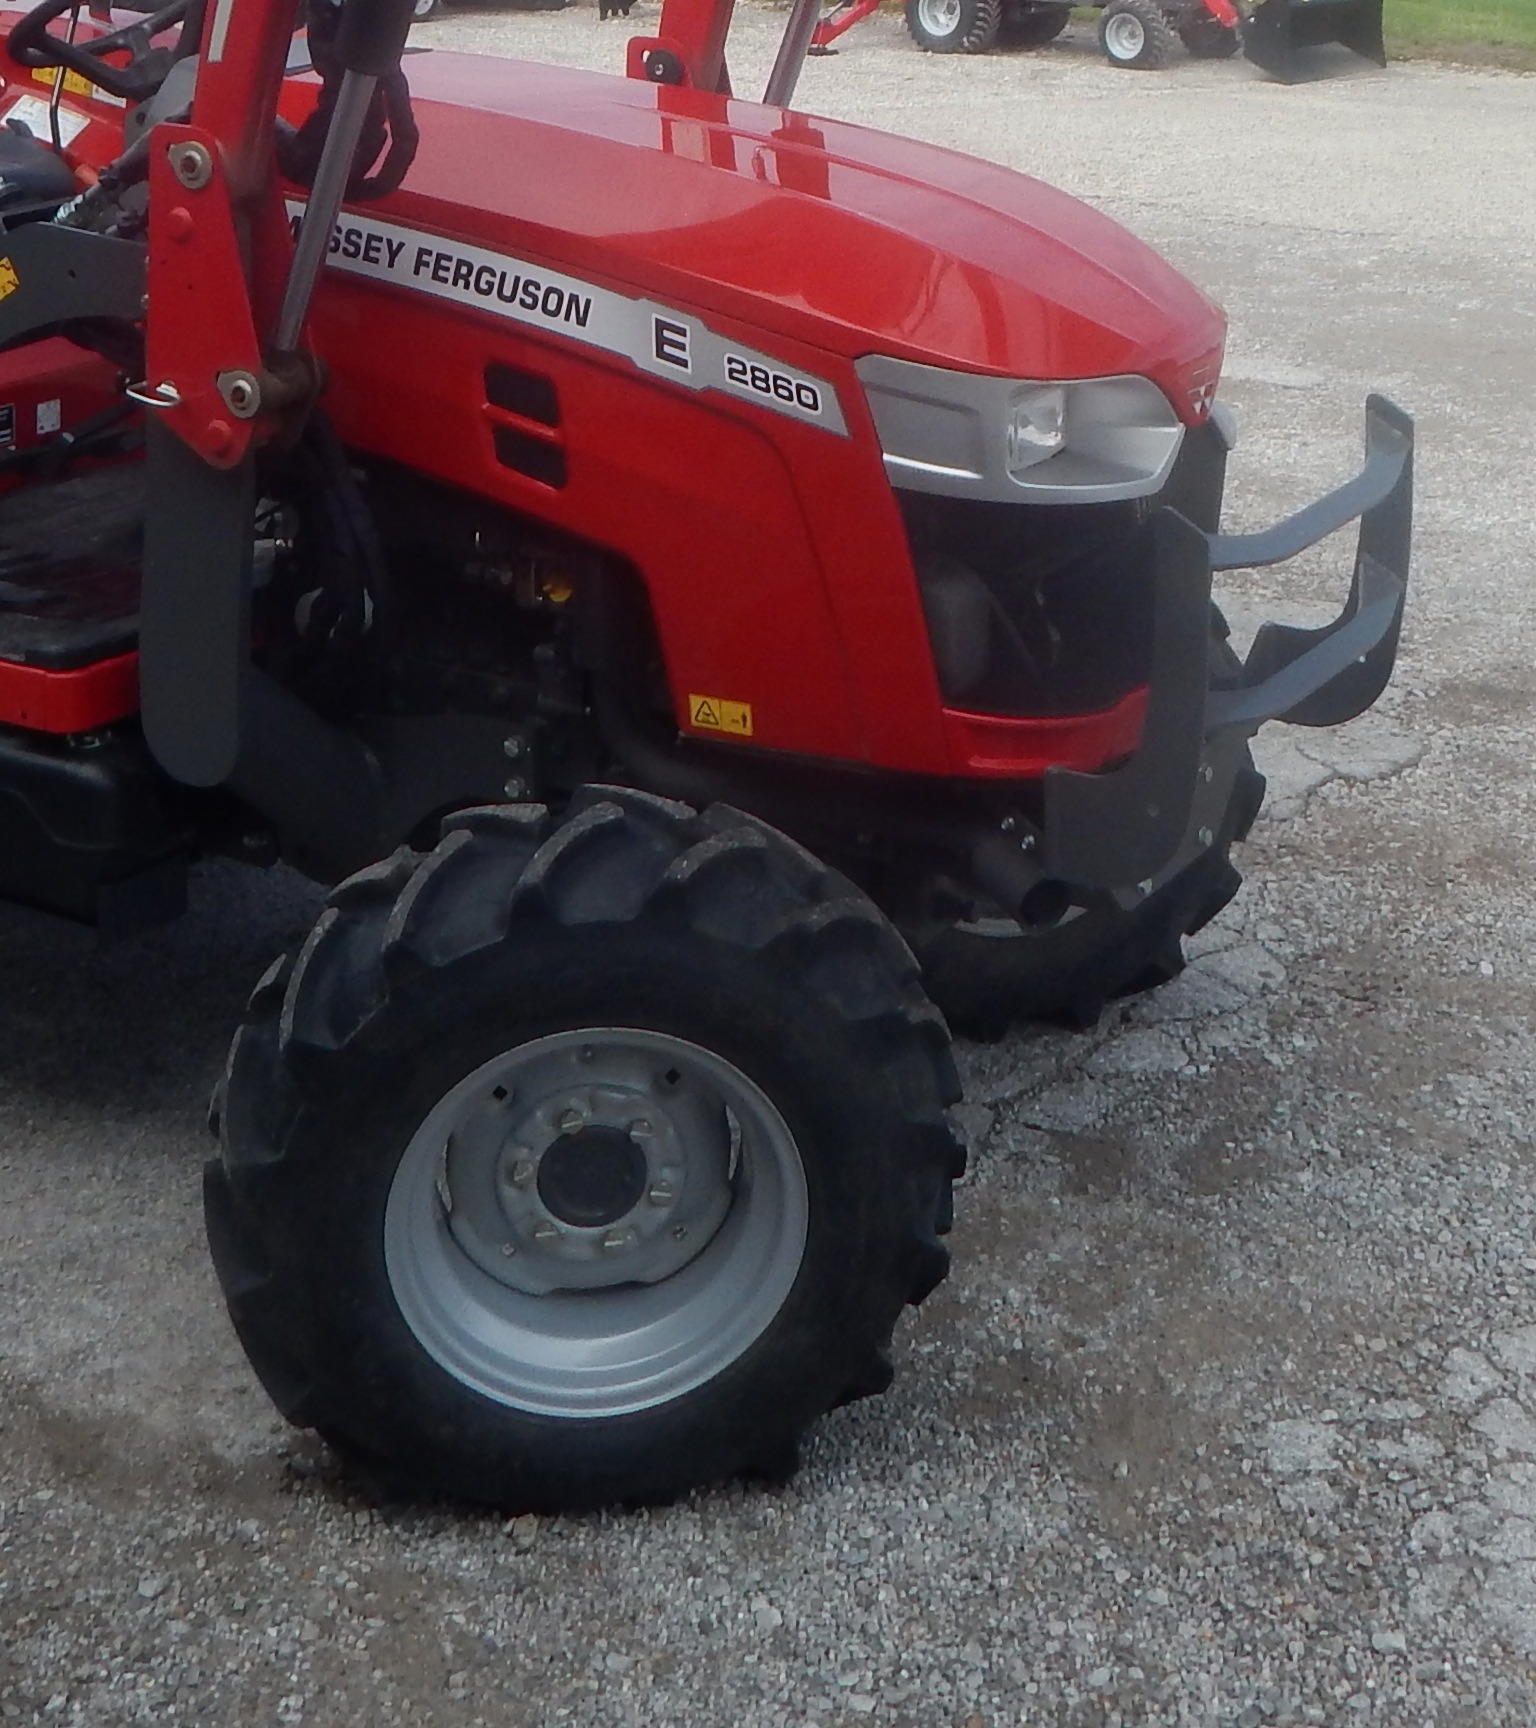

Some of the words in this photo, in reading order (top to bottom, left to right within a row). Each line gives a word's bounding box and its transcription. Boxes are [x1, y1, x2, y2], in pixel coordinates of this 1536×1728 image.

[413, 246, 592, 328] FERGUSON
[653, 315, 690, 371] E
[725, 355, 820, 413] 2860
